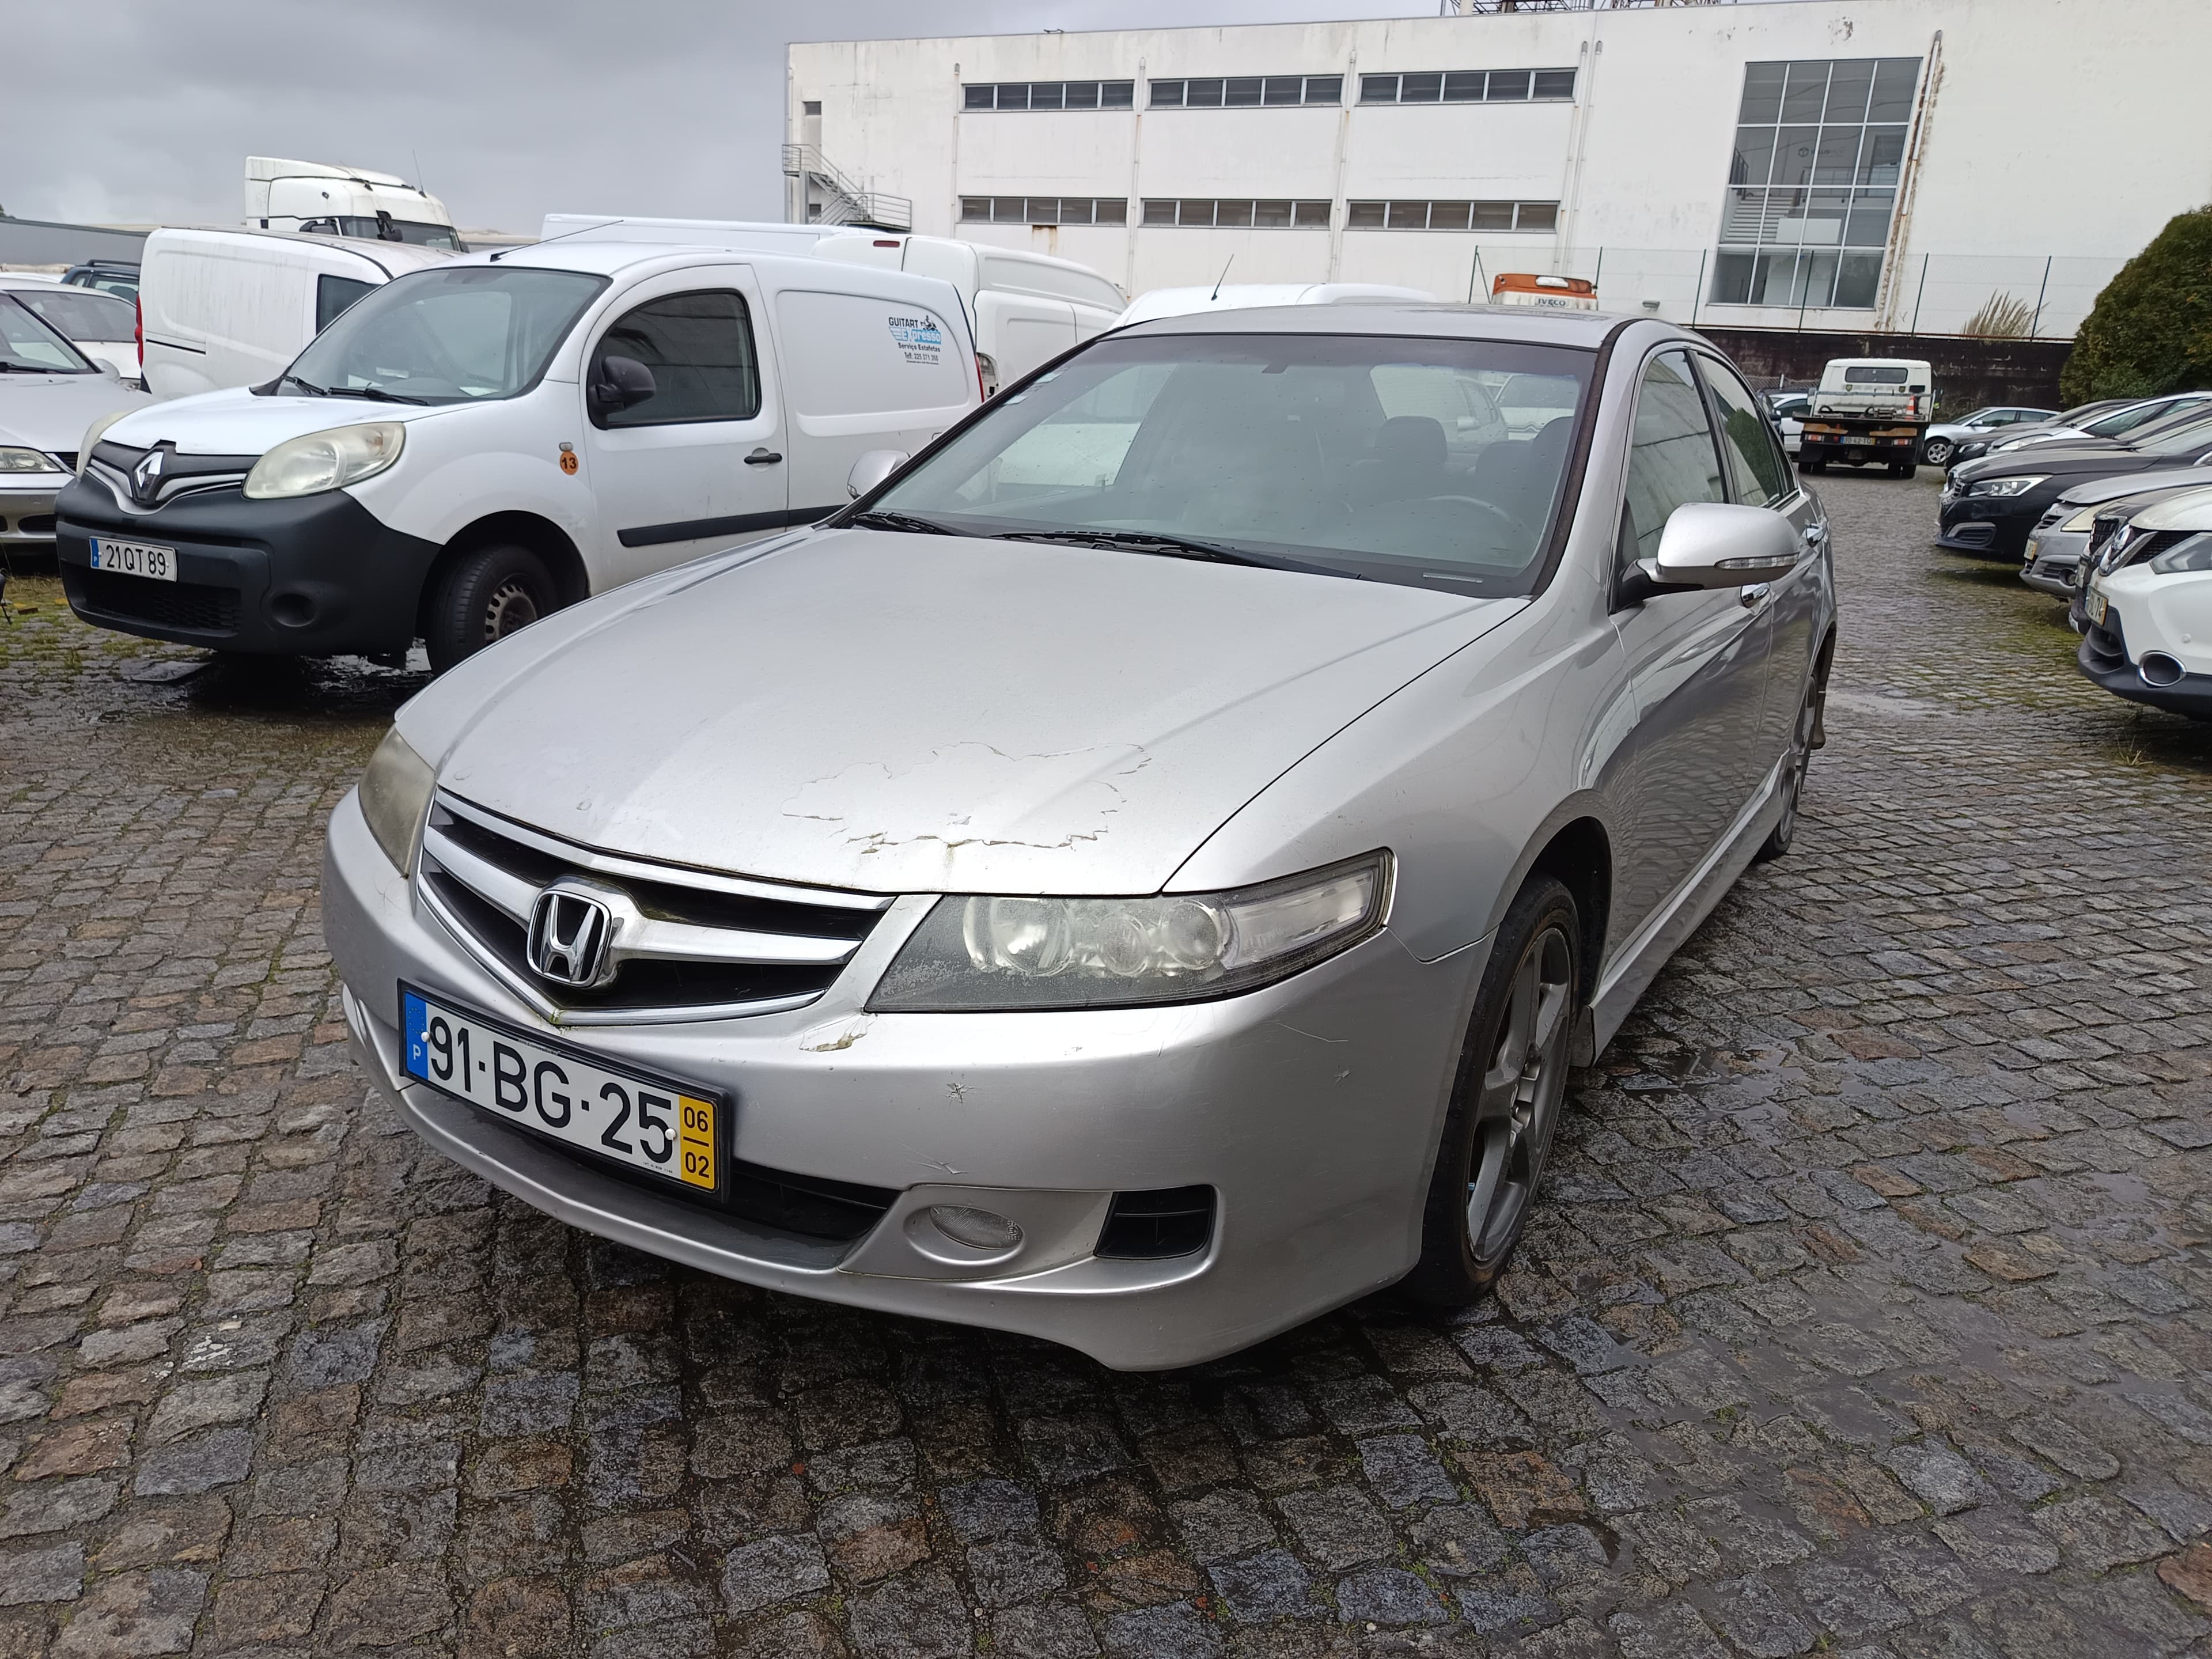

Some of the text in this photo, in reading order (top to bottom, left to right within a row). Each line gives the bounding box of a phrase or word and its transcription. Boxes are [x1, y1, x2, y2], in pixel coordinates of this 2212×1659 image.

[1538, 298, 1566, 306] IVECO
[888, 316, 918, 328] GUITART
[898, 342, 941, 353] Serviço Estafetas
[562, 457, 577, 469] 13
[106, 544, 166, 576] 21 QT 89
[412, 1043, 421, 1060] P
[684, 1106, 709, 1132] 06
[684, 1152, 710, 1179] 02
